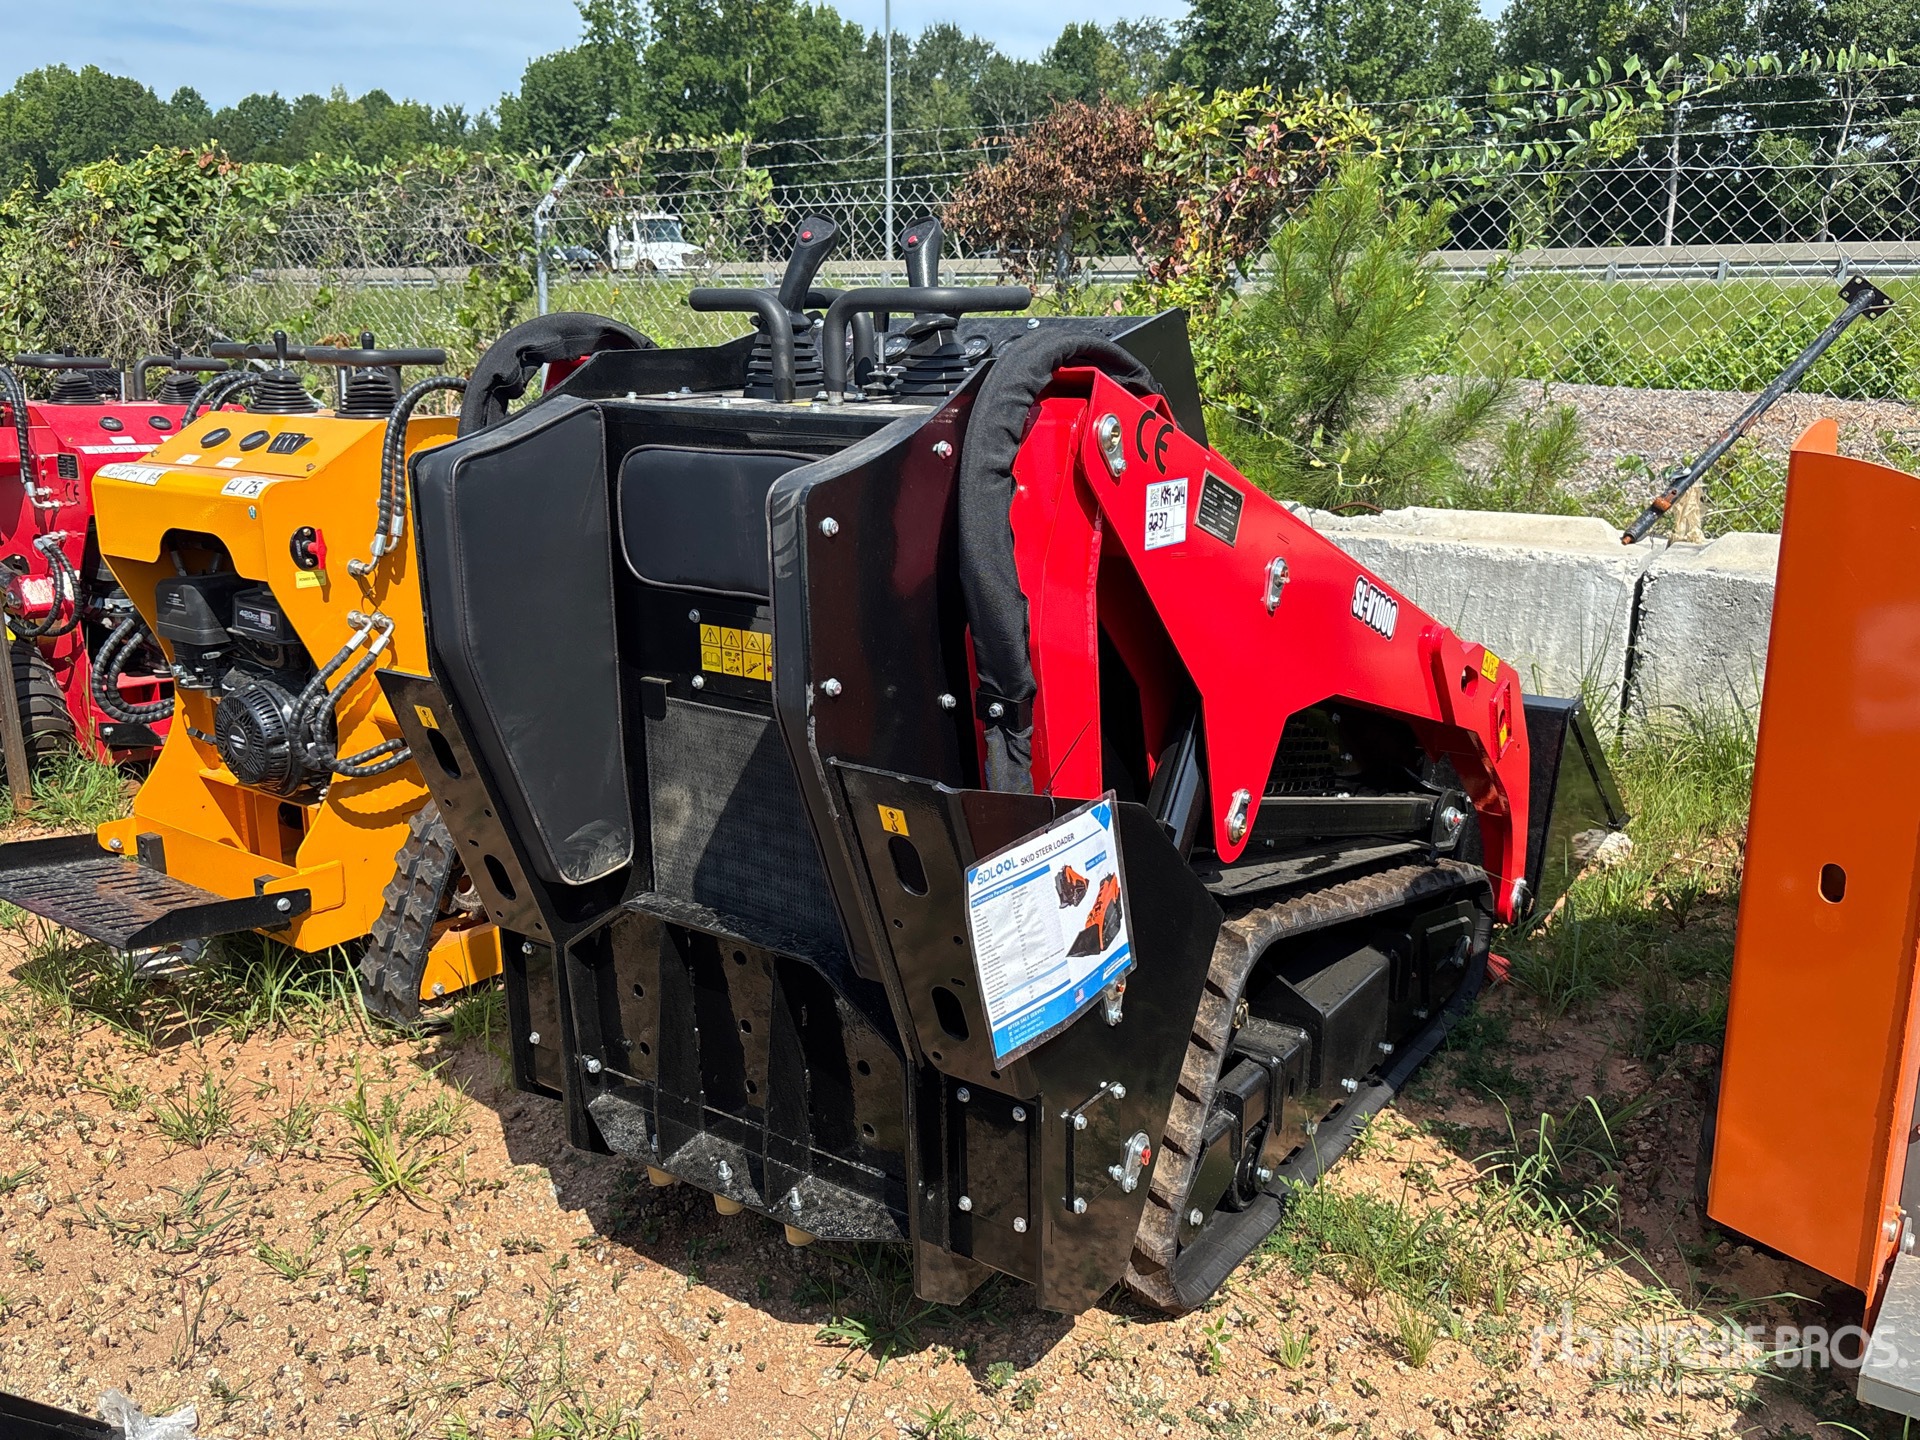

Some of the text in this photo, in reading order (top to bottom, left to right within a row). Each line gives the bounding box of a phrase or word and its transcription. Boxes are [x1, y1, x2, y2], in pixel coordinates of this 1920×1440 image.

[1136, 409, 1174, 475] CE
[1148, 511, 1168, 531] 2237
[977, 832, 1075, 885] SDLOOL SKID STEER LOADER
